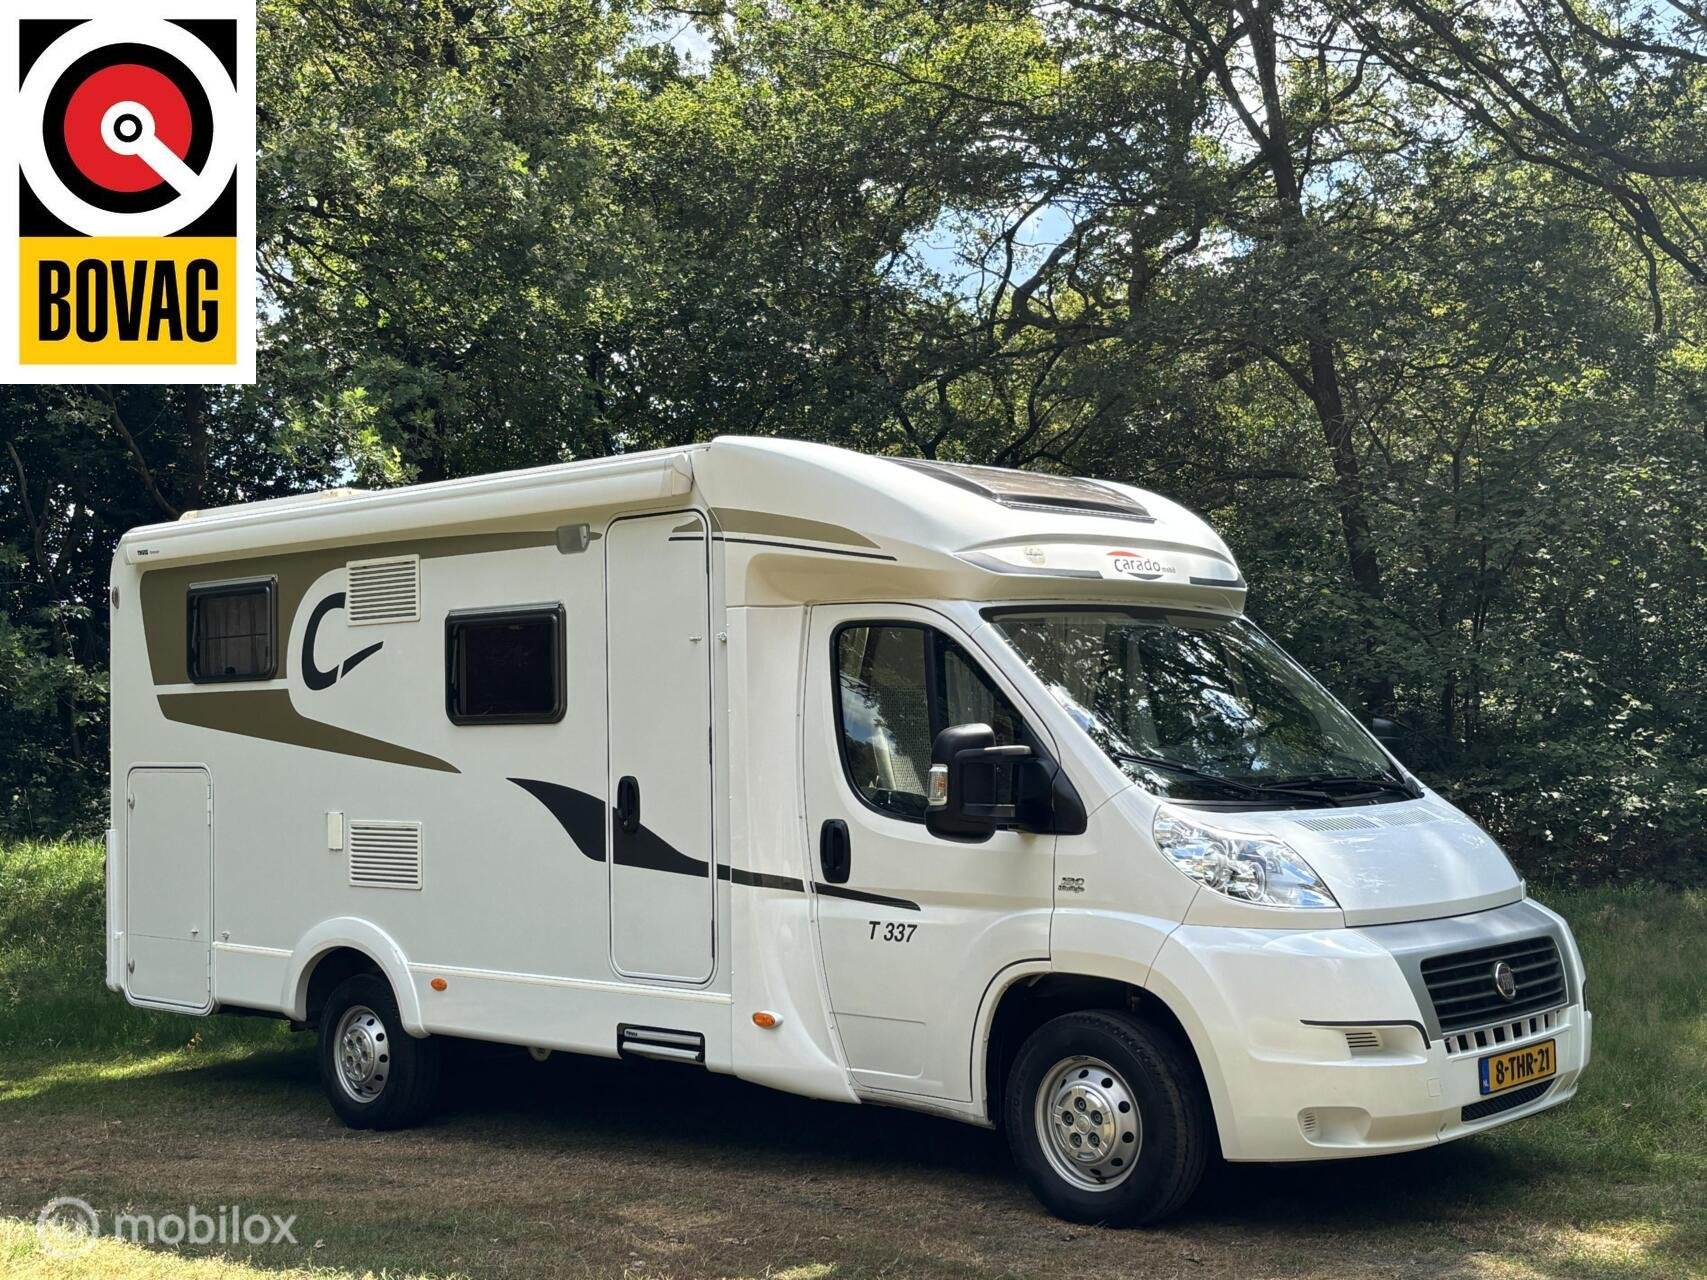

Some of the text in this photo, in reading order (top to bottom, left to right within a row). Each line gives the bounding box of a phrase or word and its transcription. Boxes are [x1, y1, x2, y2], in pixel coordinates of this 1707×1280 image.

[868, 921, 918, 943] T 337
[1495, 1047, 1551, 1085] 8-THR-21
